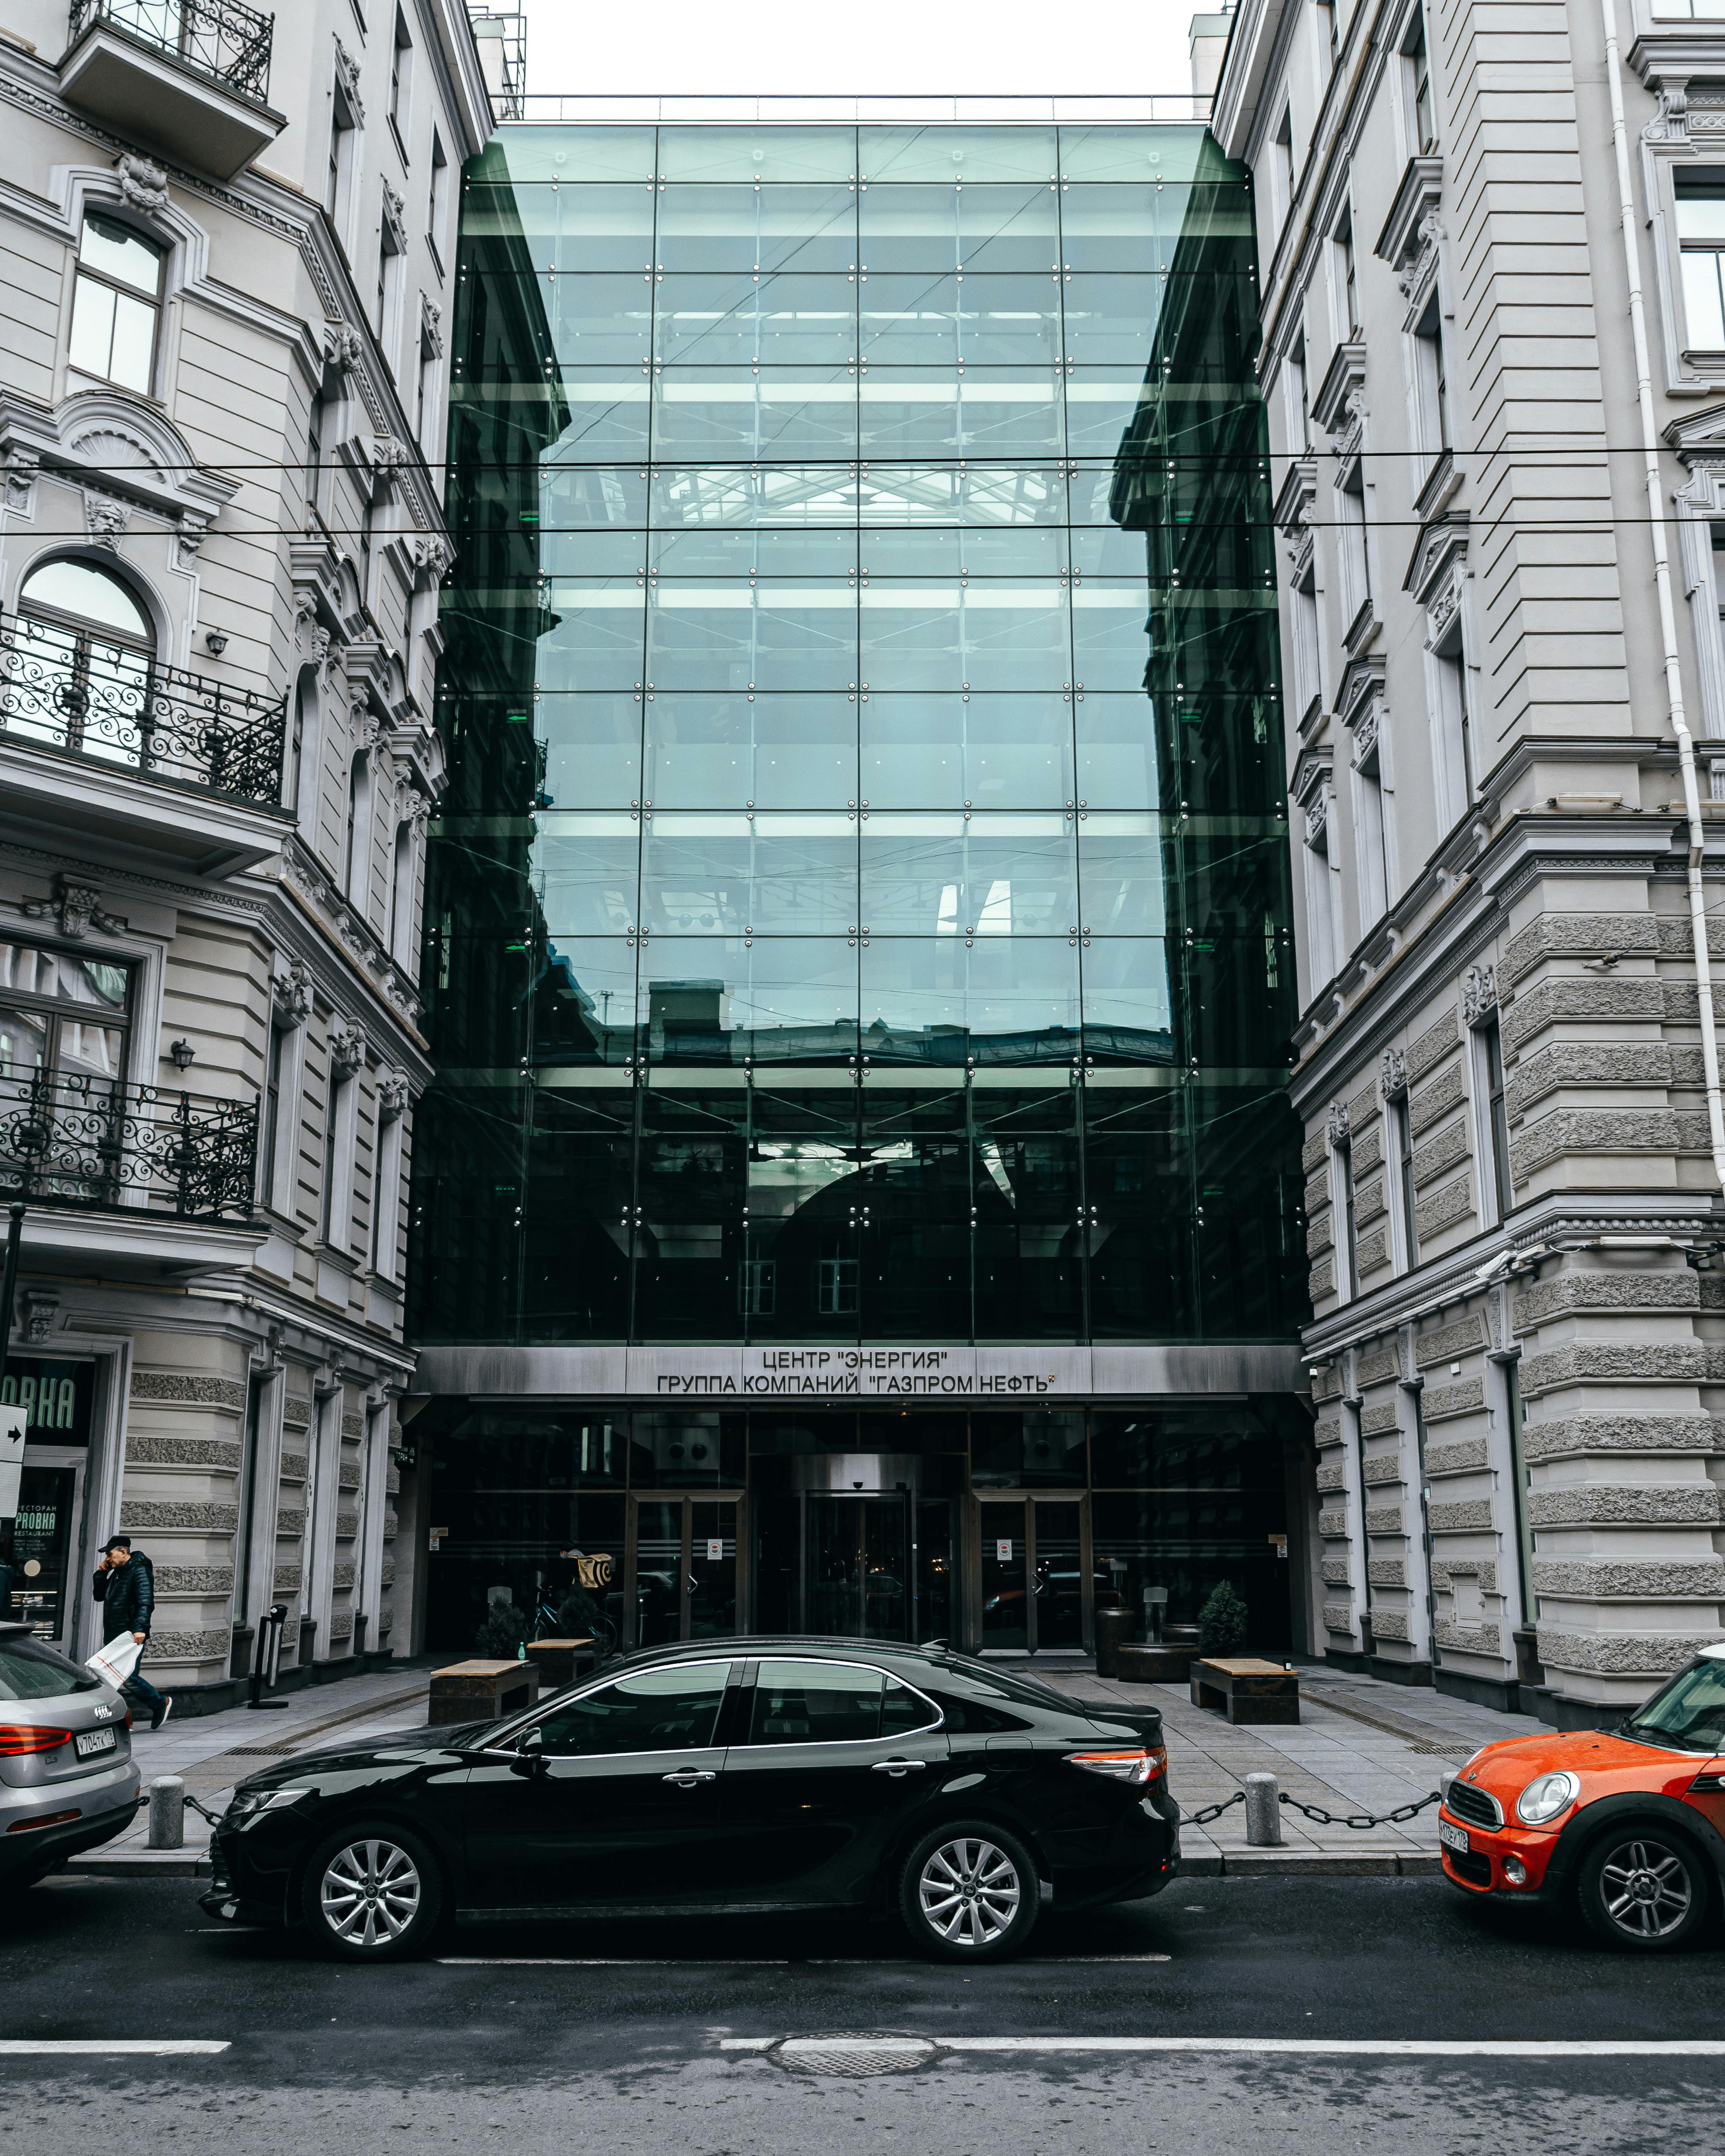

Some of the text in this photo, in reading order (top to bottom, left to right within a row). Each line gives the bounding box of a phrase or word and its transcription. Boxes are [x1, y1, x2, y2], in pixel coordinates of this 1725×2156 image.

[764, 1351, 947, 1372] ЦЕНТР "ЭНЕРГИЯ"
[657, 1372, 1055, 1393] ГРУППА КОМПАНИЙ "ГАЗПРОМ НЕФТЬ"
